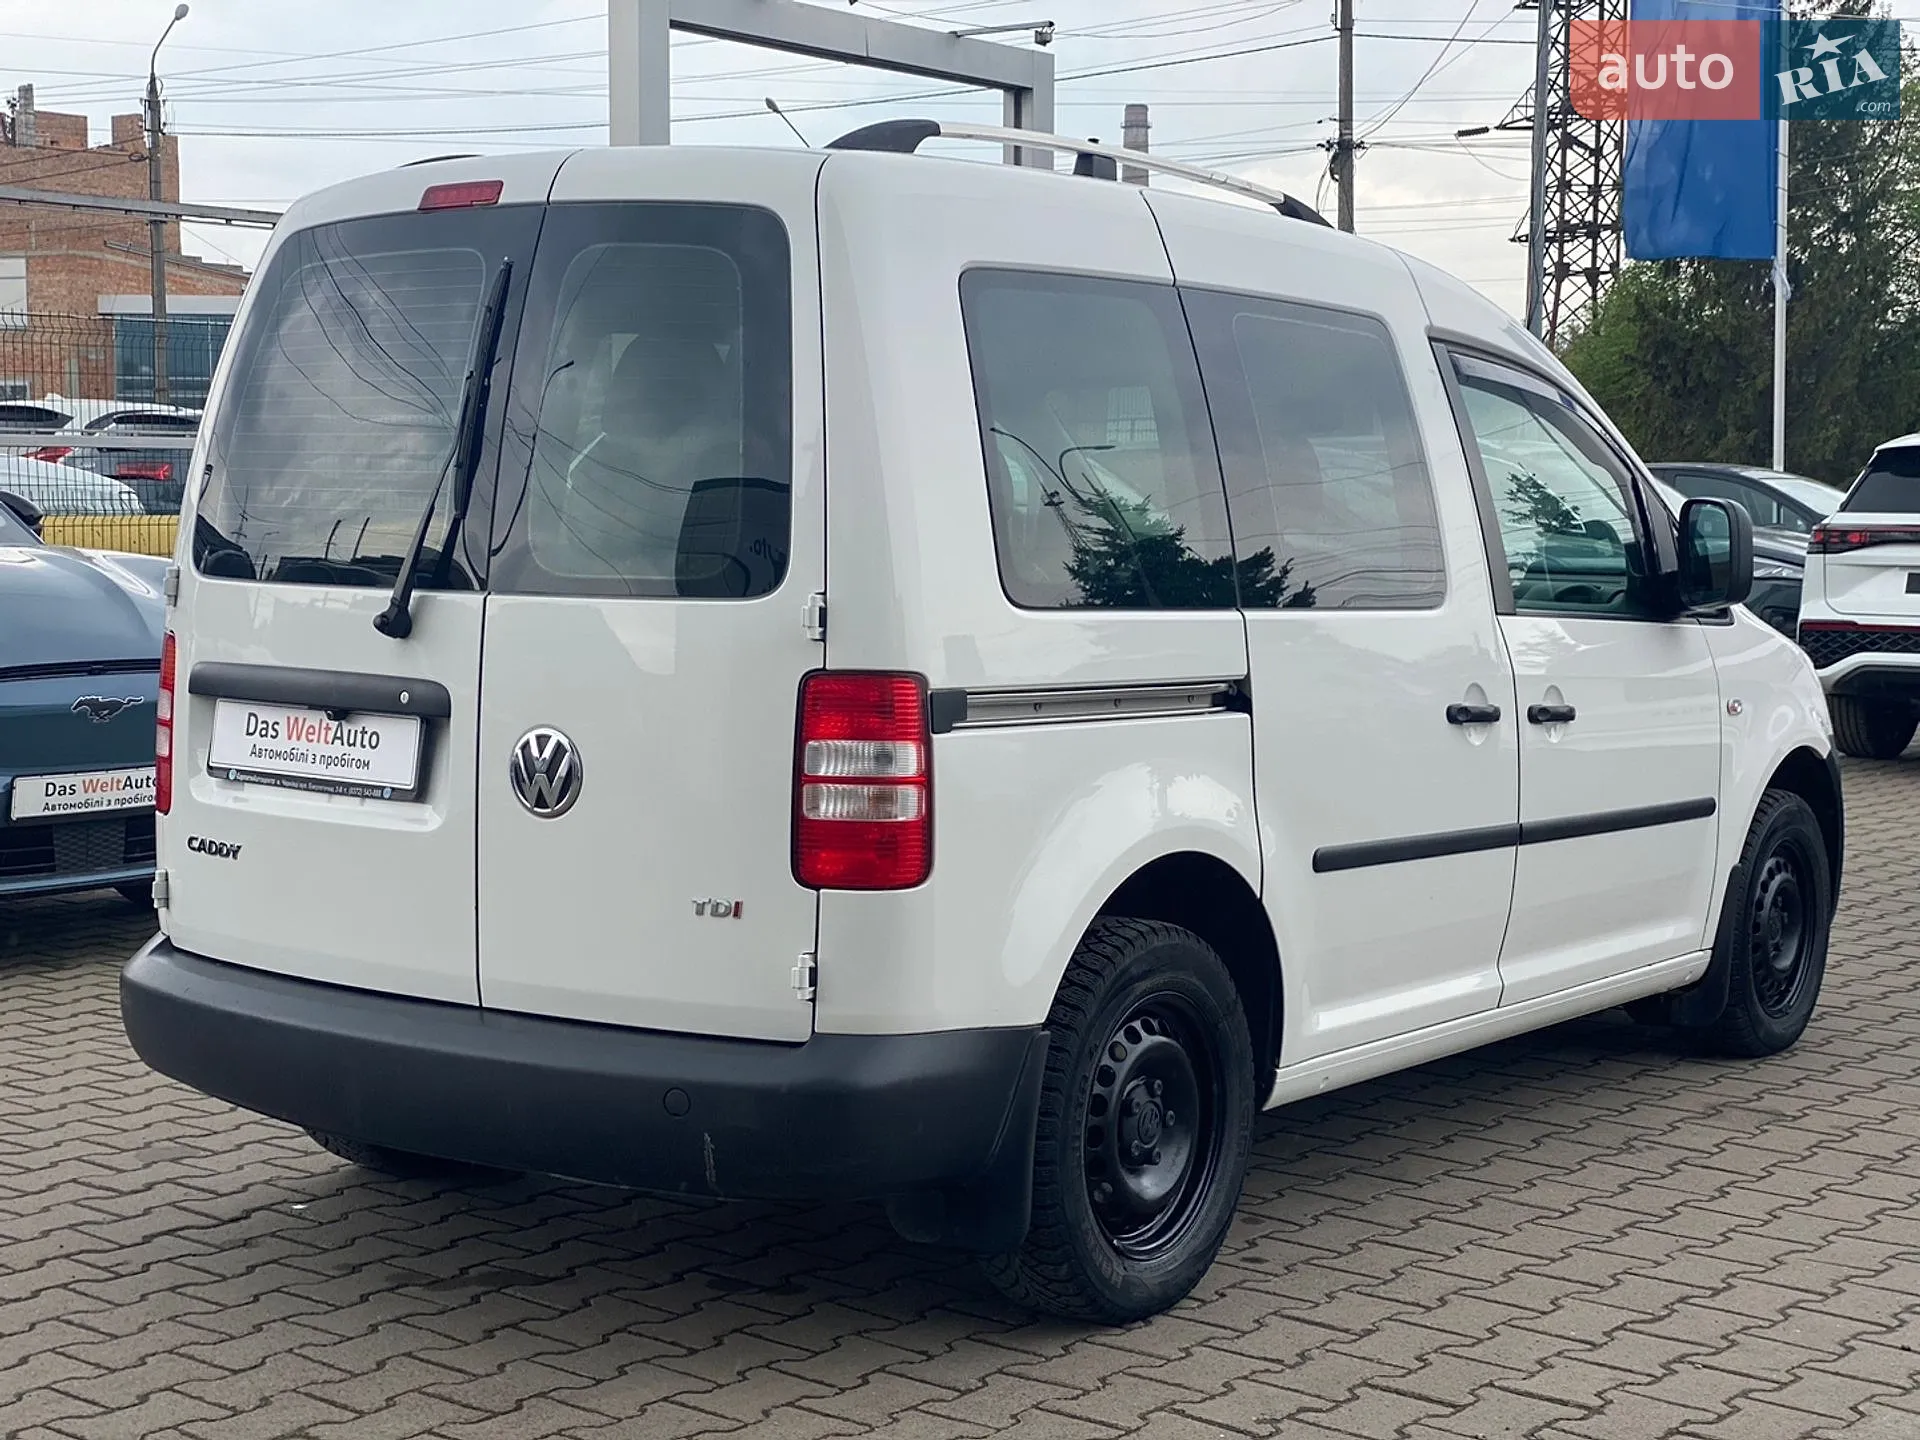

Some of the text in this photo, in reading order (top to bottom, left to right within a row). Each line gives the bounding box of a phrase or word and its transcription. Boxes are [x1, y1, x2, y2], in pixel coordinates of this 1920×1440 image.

[245, 712, 380, 751] Das WeltAuto
[249, 743, 370, 771] Автомобілі з пробігом
[45, 782, 76, 797] Das
[43, 793, 156, 812] Автомобілі з пробіго
[187, 836, 242, 860] CADDY
[691, 897, 744, 919] TDI
